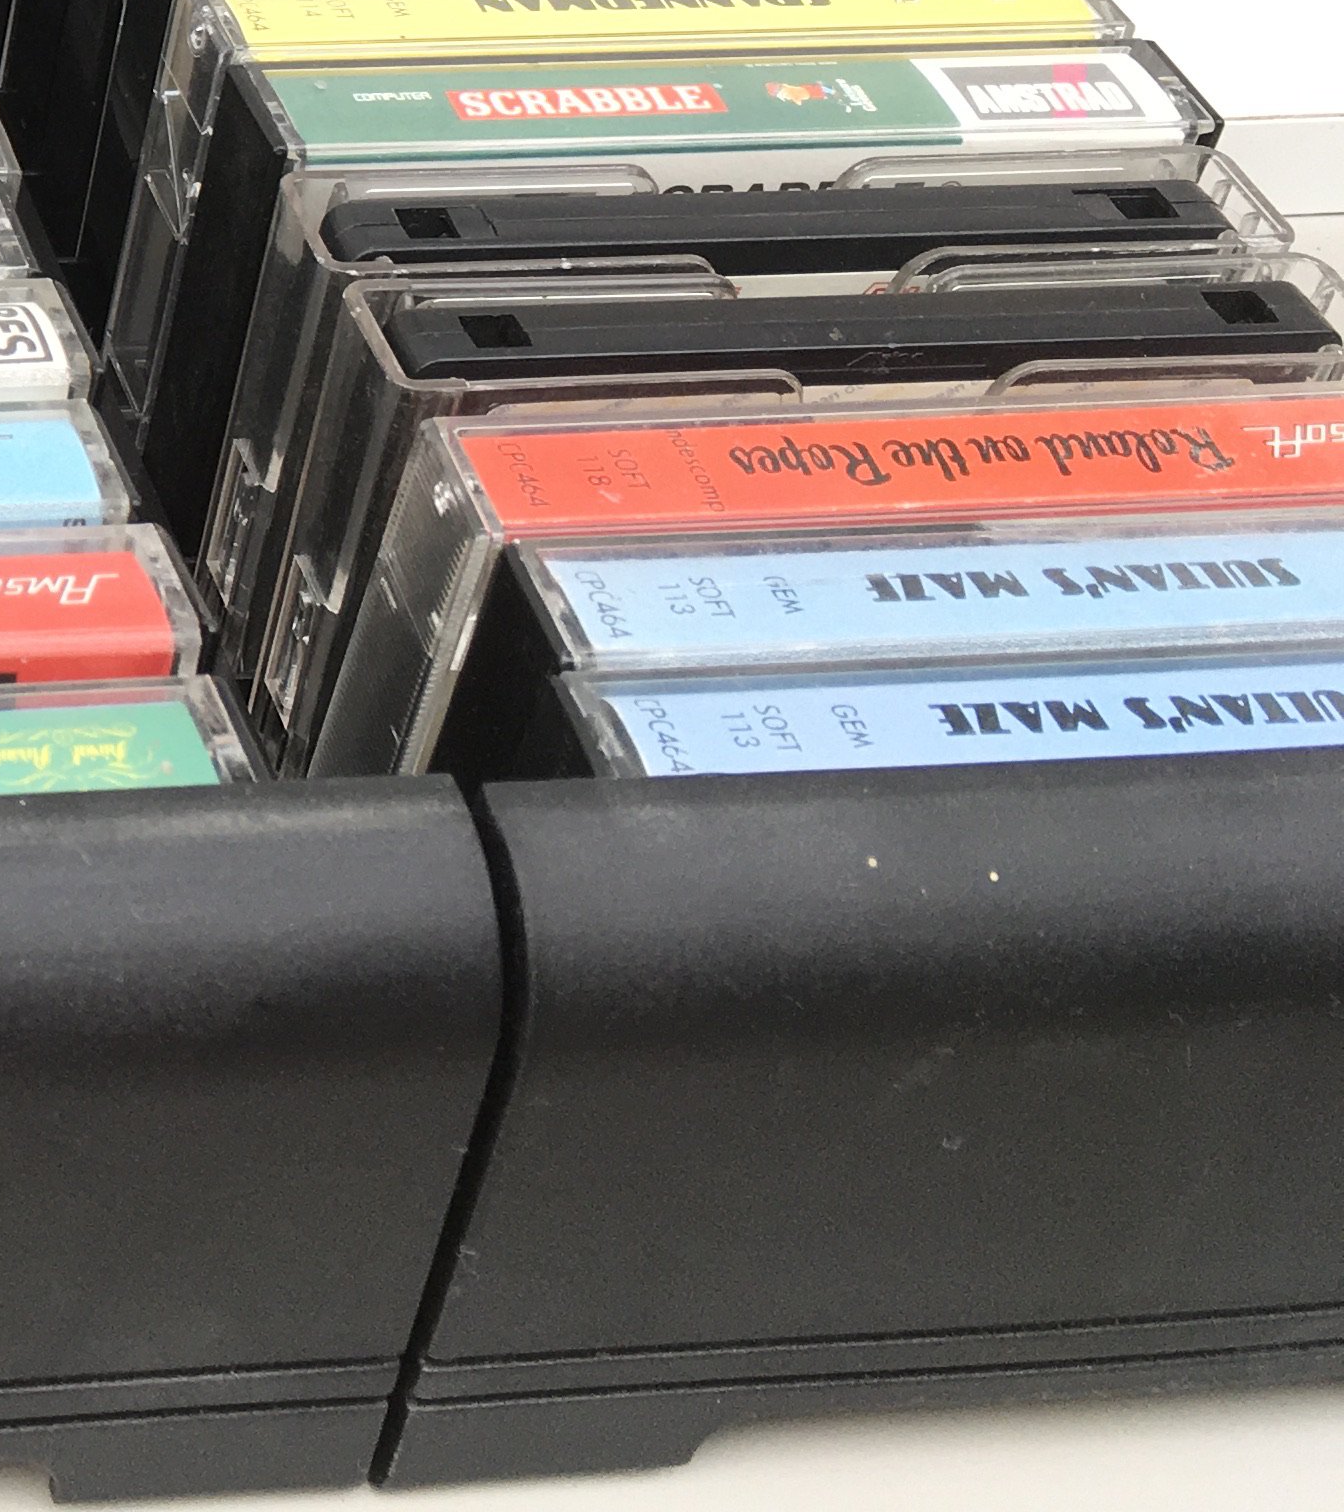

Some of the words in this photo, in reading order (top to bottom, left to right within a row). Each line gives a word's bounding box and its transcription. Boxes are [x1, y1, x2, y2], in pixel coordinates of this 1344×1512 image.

[460, 90, 711, 116] SCRABBLE
[729, 437, 891, 486] Ropes
[882, 439, 967, 481] the
[966, 440, 1030, 479] on
[1035, 427, 1233, 475] Roland
[865, 570, 1030, 602] MAZE
[1041, 559, 1301, 599] SULTAN'S
[930, 699, 1109, 734] MAZE
[1122, 690, 1344, 733] ULTAN'S
